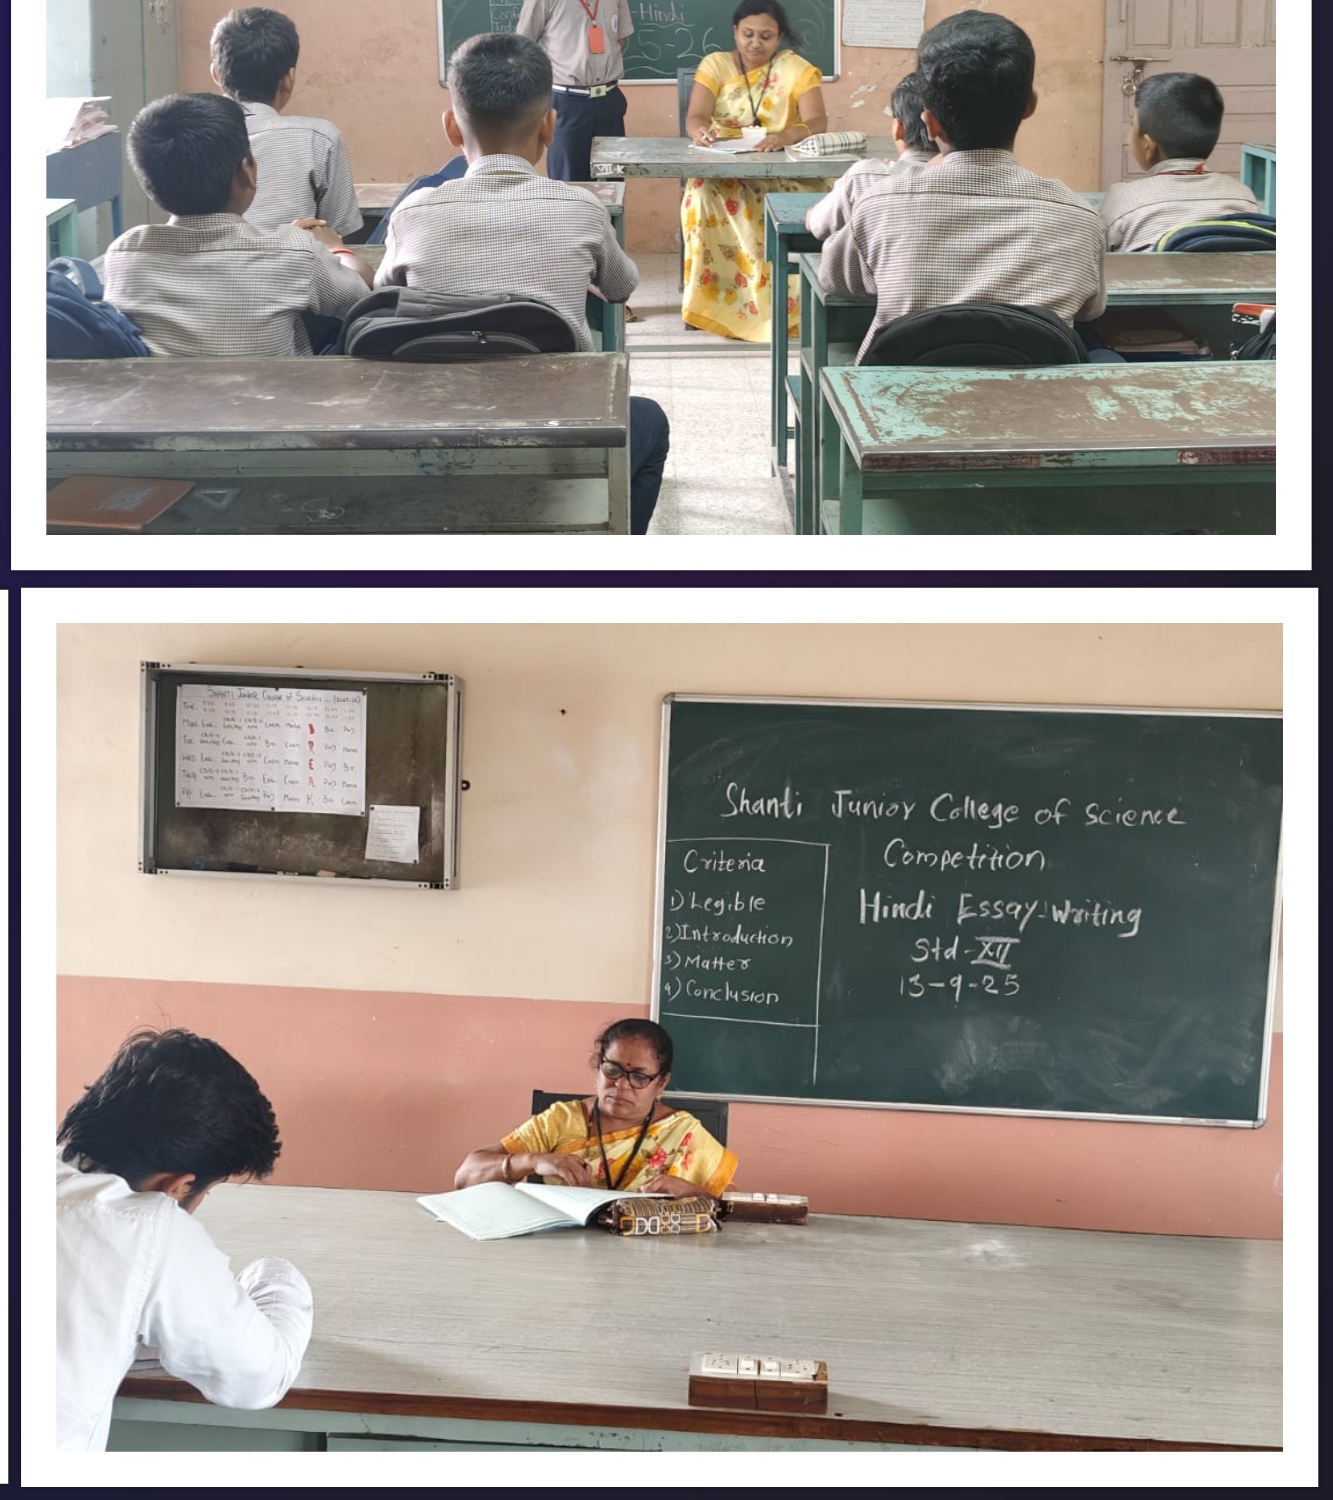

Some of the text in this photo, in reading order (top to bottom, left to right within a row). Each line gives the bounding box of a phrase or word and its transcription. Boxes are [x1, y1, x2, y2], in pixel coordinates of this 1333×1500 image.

[720, 782, 803, 820] Shanti
[831, 789, 916, 820] Junior
[930, 793, 1020, 829] College
[1035, 797, 1071, 826] of
[683, 849, 767, 874] Criteria
[883, 838, 1046, 872] Competition
[859, 888, 935, 924] Hindi
[684, 954, 752, 971] Matter
[686, 978, 780, 1005] Conclusion
[899, 974, 1021, 1002] 13-9-25
